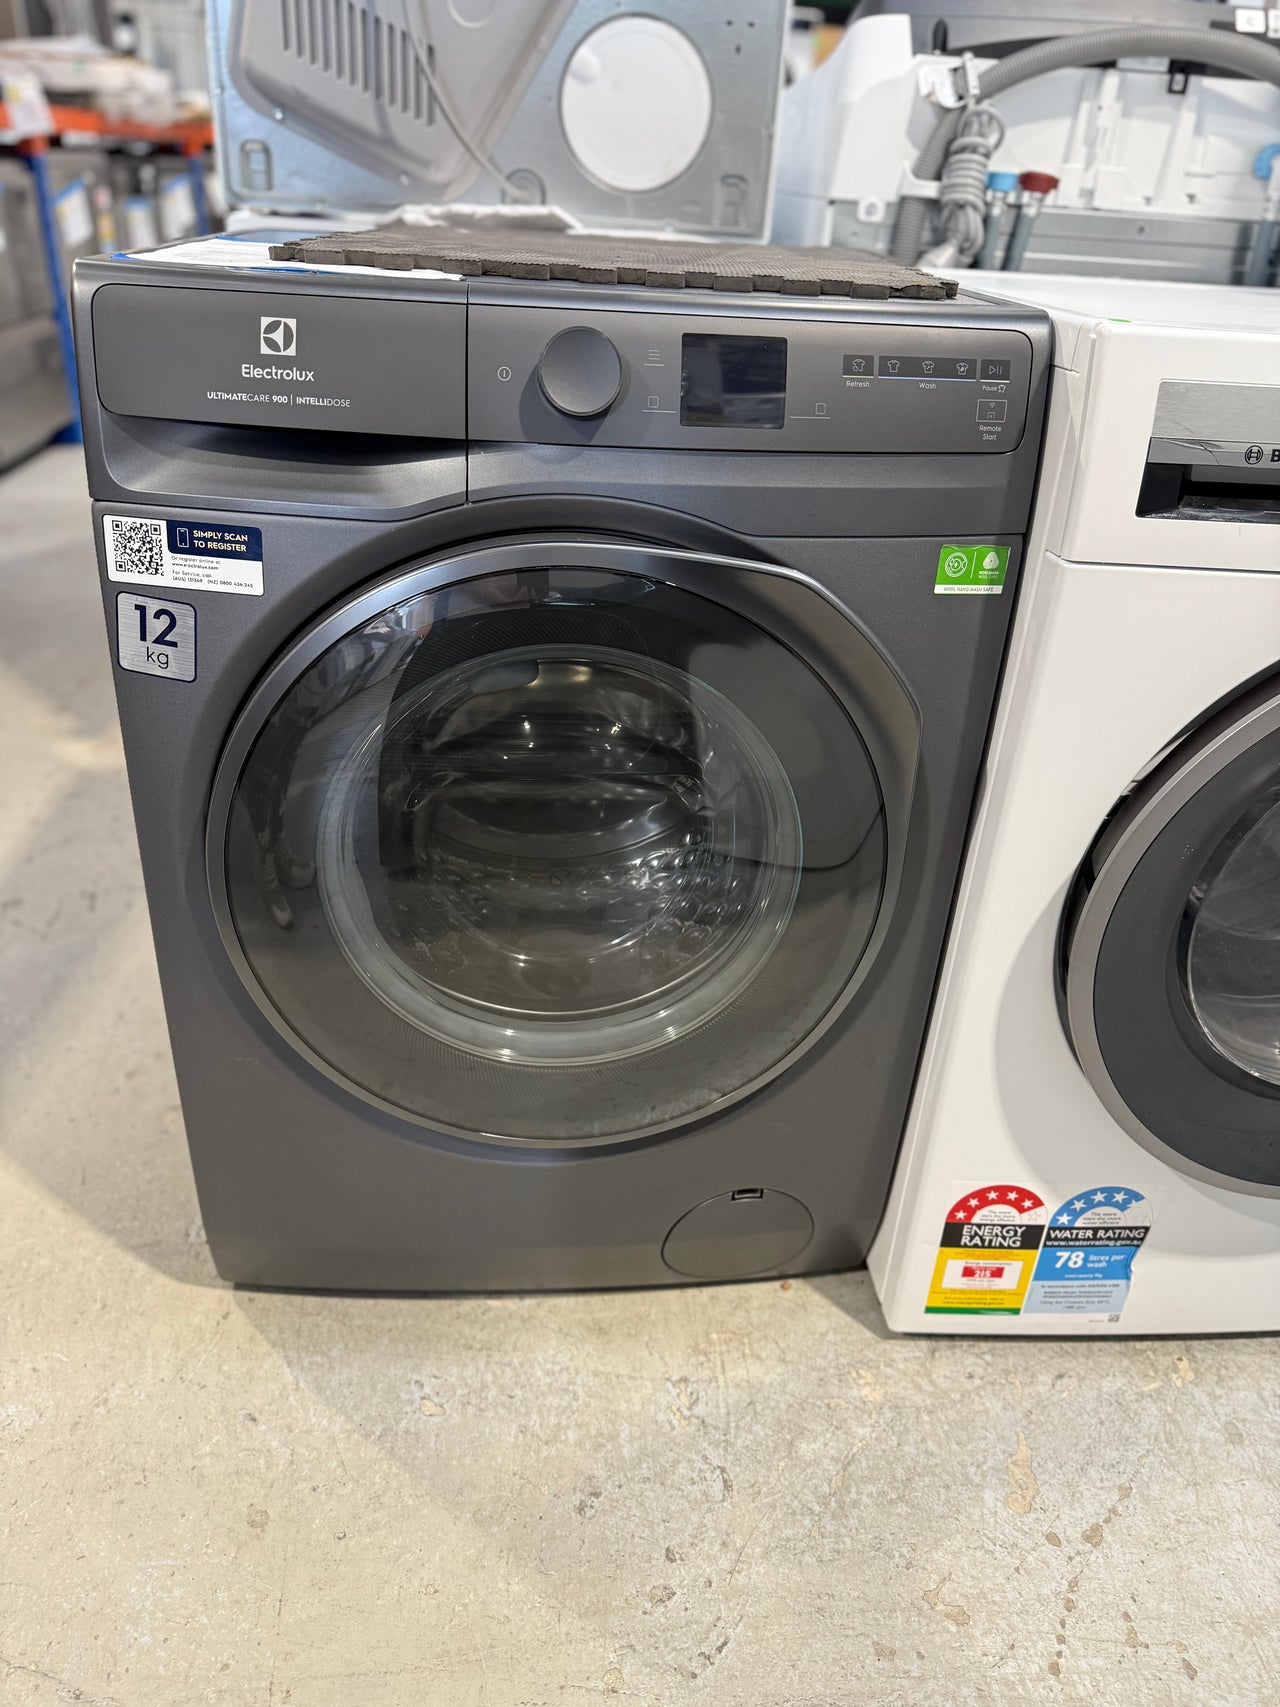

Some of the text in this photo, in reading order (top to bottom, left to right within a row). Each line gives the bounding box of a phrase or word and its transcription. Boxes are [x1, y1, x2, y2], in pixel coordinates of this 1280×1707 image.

[241, 363, 315, 382] Electrolux
[846, 380, 870, 389] Refresh
[918, 382, 937, 390] Wash
[982, 384, 998, 392] Pause
[206, 391, 351, 408] ULTIMATECARE 900 INTELLIDOSE
[979, 424, 1002, 433] Remote
[982, 433, 997, 441] Start
[193, 530, 248, 542] SIMPLY SCAN
[194, 540, 247, 552] TO REGISTER
[134, 604, 178, 648] 12
[146, 646, 169, 669] kg
[962, 1224, 1026, 1237] ENERGY
[1049, 1229, 1145, 1239] WATER RATING
[960, 1236, 1022, 1247] RATING
[1055, 1251, 1126, 1269] 78 litres per
